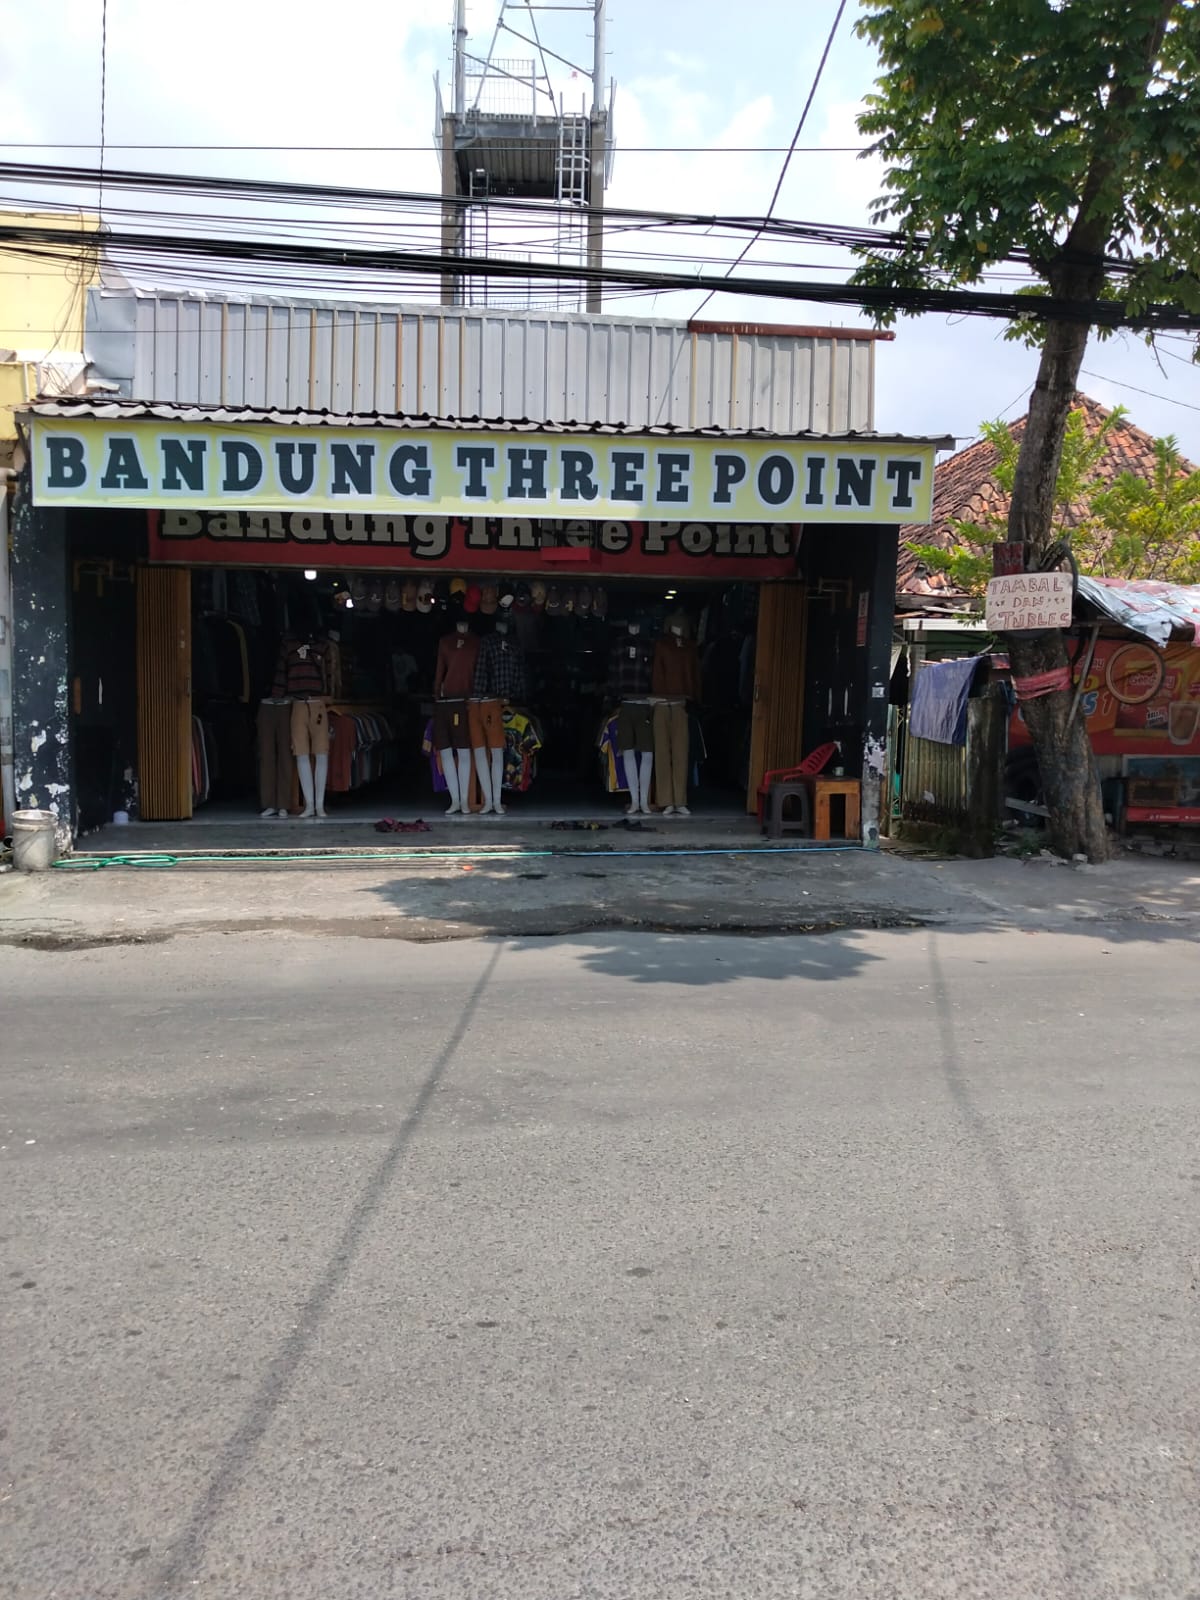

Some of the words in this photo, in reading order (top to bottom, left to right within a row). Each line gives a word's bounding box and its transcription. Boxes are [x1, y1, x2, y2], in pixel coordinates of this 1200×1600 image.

[46, 437, 431, 496] BANDUNG
[457, 447, 690, 503] THREE
[713, 455, 921, 507] POINT
[461, 517, 628, 550] Thee
[989, 577, 1063, 595] TAMBAL
